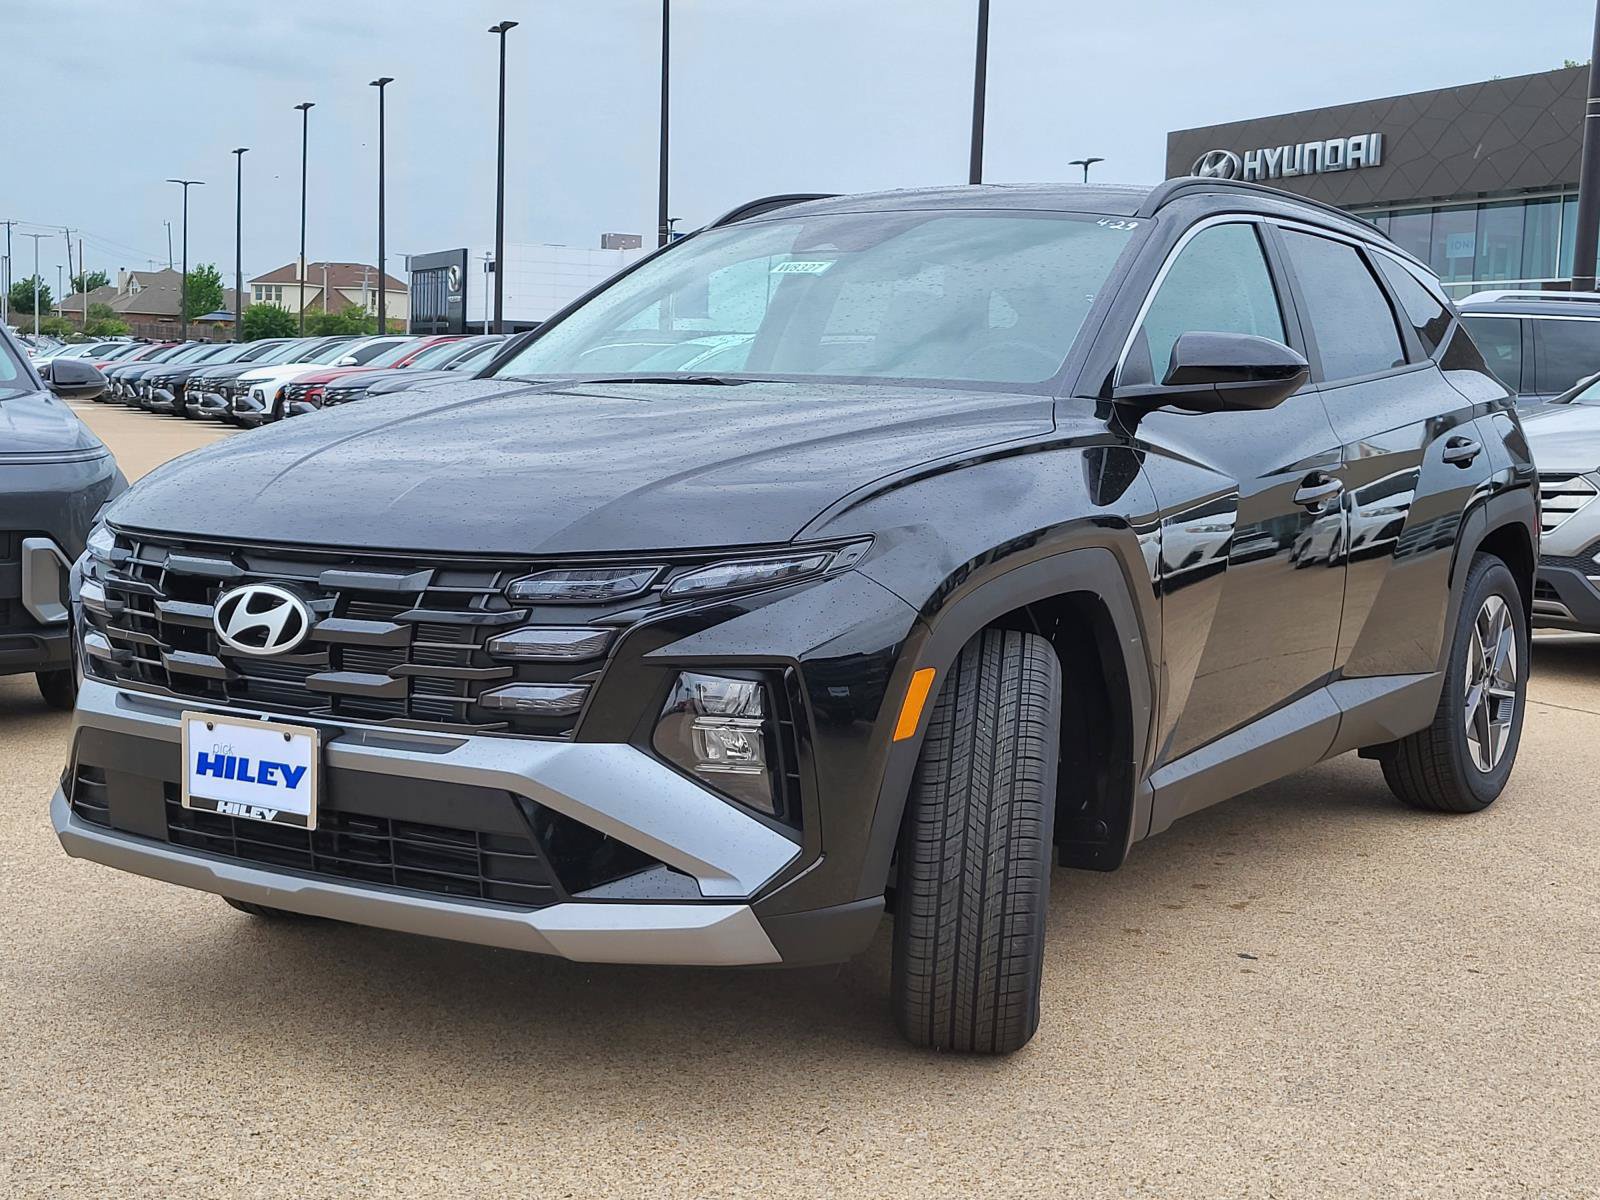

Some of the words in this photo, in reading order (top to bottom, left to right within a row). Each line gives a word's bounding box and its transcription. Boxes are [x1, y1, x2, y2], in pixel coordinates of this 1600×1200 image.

[1244, 133, 1382, 181] HYUNDAI
[1096, 218, 1139, 231] 4-29
[777, 263, 825, 272] W8327
[212, 741, 235, 756] pick
[196, 752, 307, 789] HILEY
[216, 800, 278, 821] HILEY
